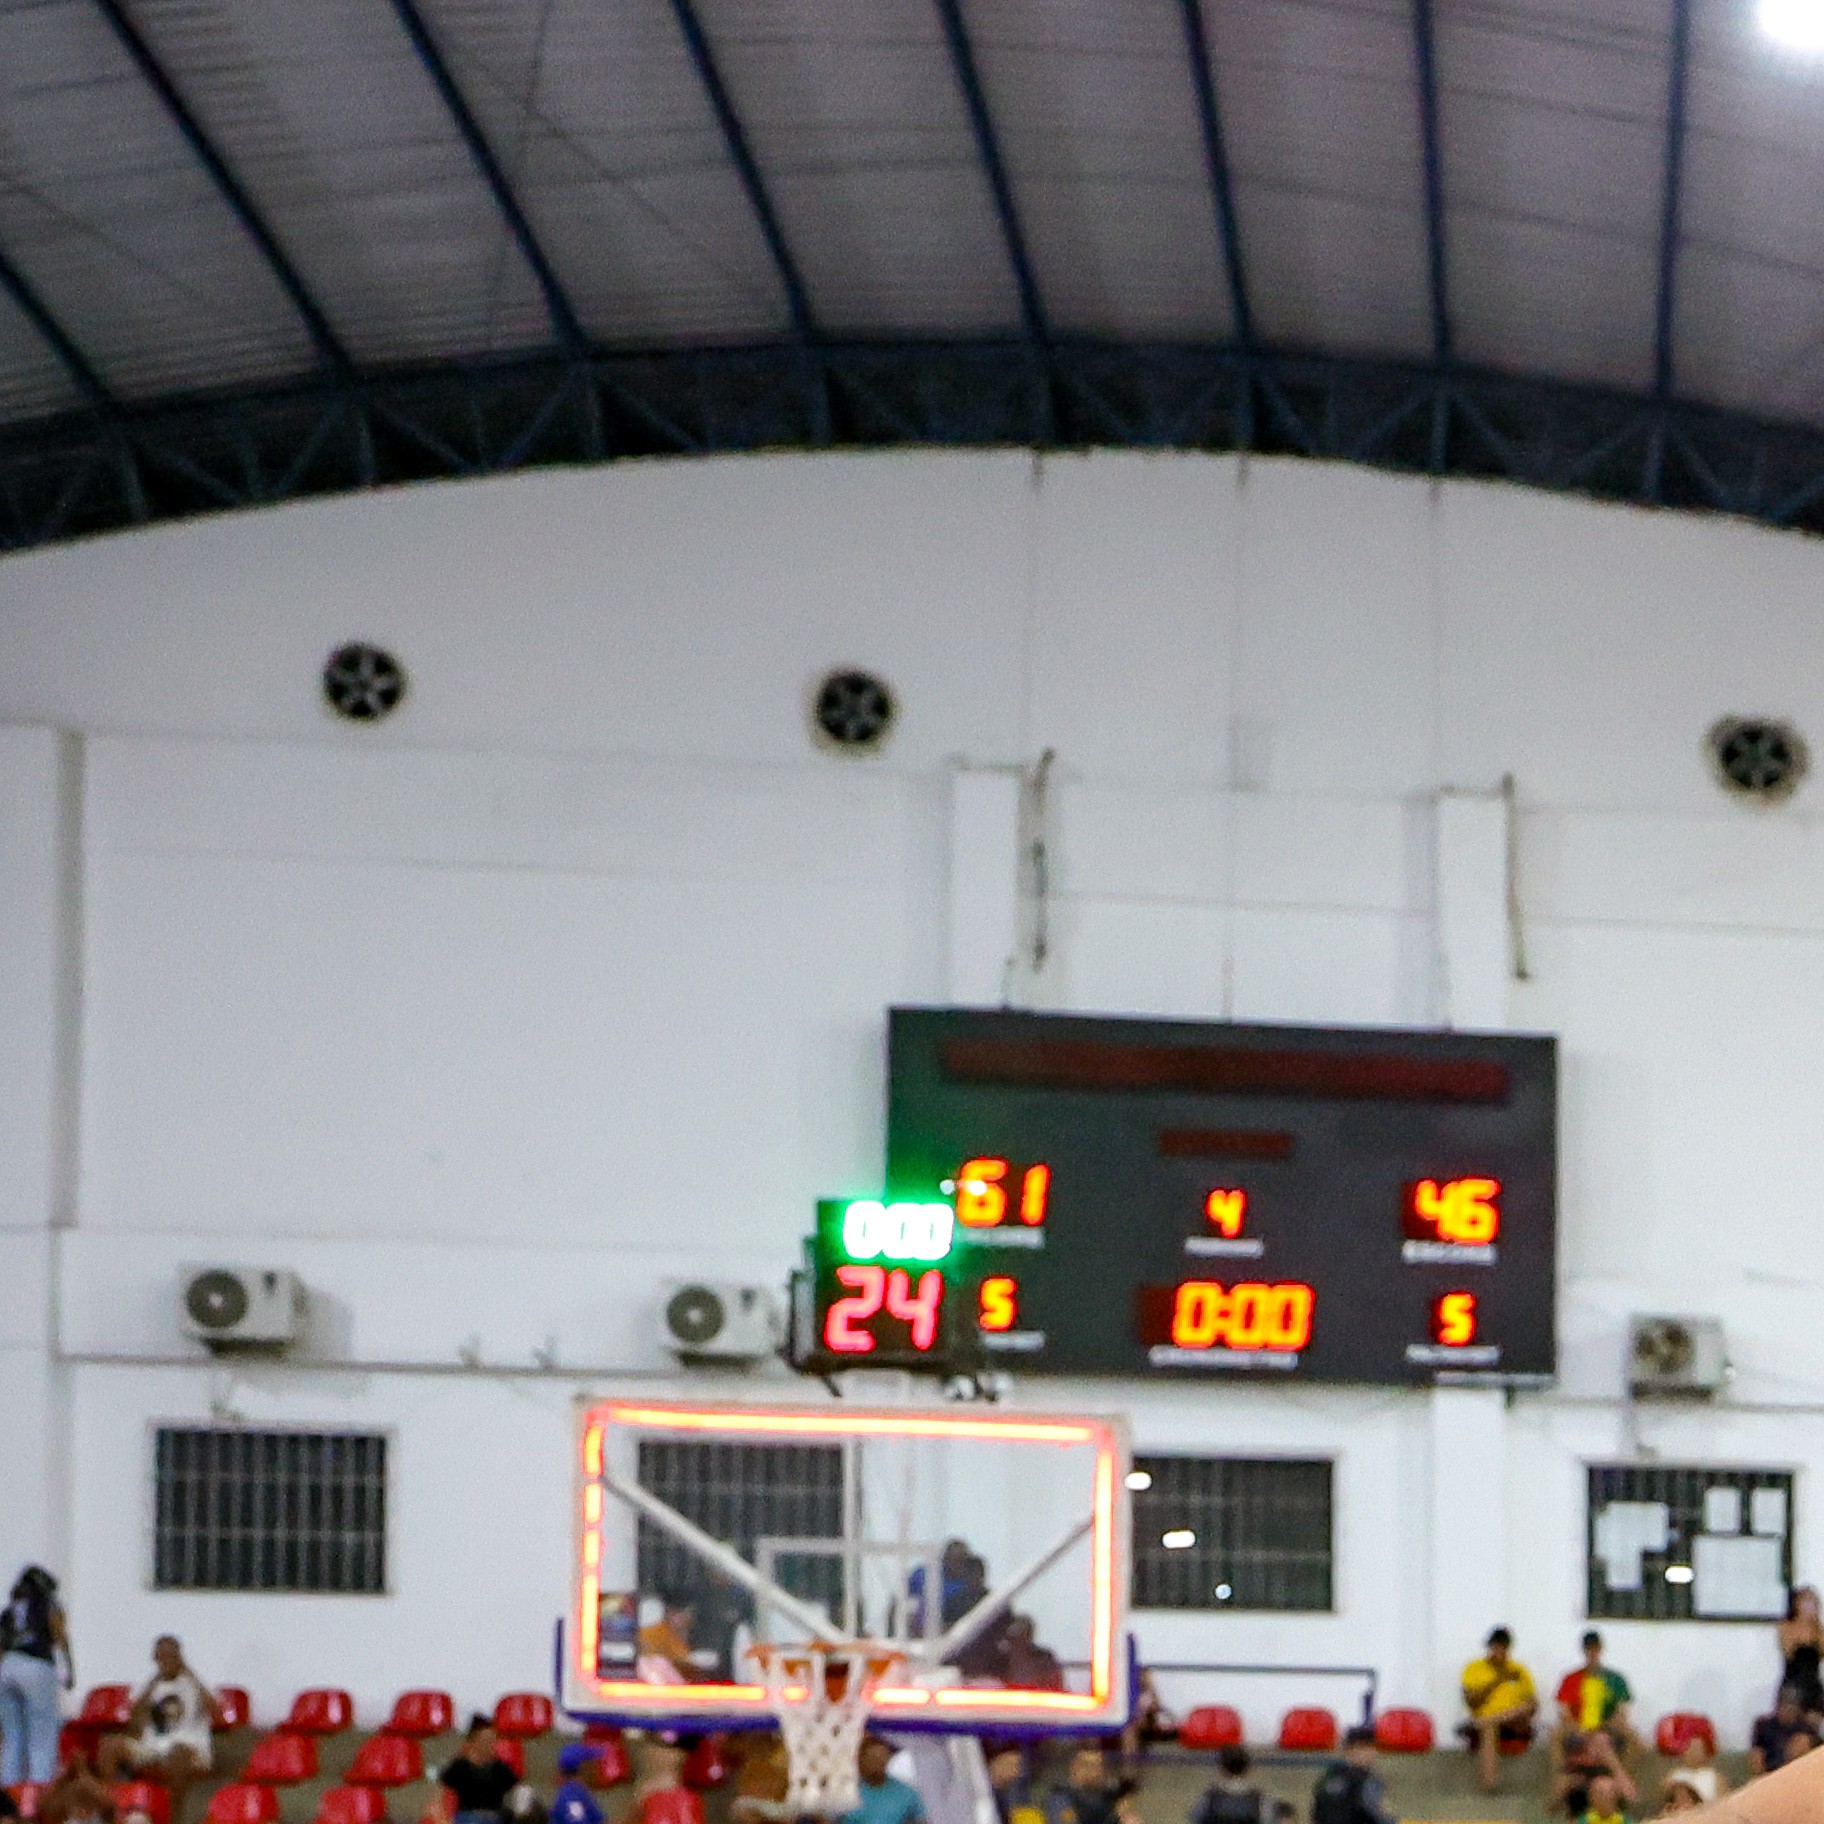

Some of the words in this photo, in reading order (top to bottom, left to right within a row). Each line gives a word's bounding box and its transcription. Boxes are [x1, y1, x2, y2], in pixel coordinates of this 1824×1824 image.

[956, 1157, 1051, 1228] 61
[1204, 1186, 1247, 1238] 4
[1414, 1176, 1501, 1246] 46
[824, 1265, 943, 1354] 24
[979, 1273, 1018, 1332] 5
[1172, 1278, 1315, 1351] 0:00
[1438, 1290, 1477, 1347] 5
